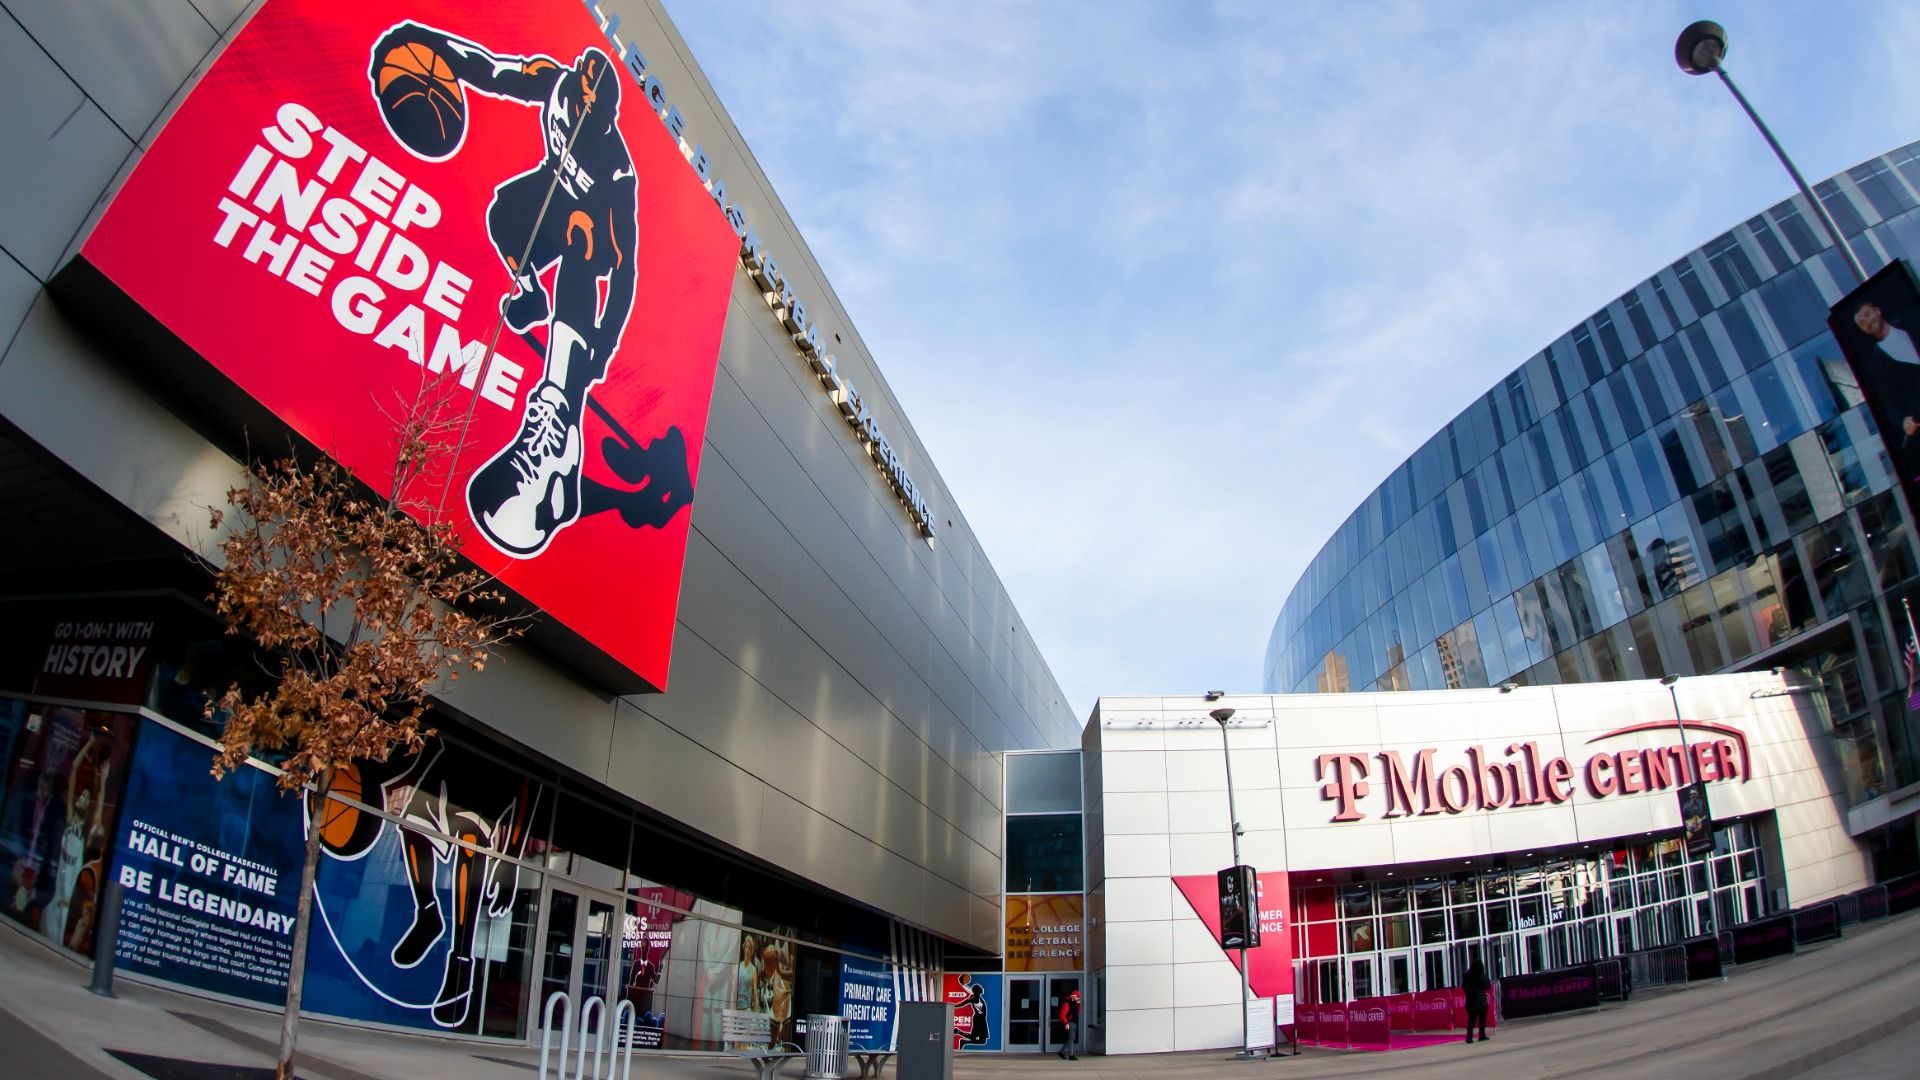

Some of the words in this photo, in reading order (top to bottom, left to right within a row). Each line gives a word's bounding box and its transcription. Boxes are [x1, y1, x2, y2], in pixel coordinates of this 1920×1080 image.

[261, 102, 441, 231] STEP
[229, 144, 473, 322] INSIDE
[211, 197, 335, 298] THE
[330, 276, 525, 411] GAME
[847, 379, 937, 537] EXPERIENCE
[54, 622, 74, 639] GO
[74, 622, 113, 640] 1-ON-1
[115, 621, 155, 640] WITH
[43, 645, 147, 679] HISTORY
[1380, 740, 1576, 819] Mobile
[1586, 737, 1744, 799] CENTER
[128, 830, 184, 867] HALL
[190, 853, 220, 877] OF
[223, 863, 278, 896] FAME
[133, 819, 169, 839] OFFICIAL
[171, 833, 196, 848] MEN'S
[196, 843, 231, 861] COLLEGE
[232, 854, 279, 877] BASKETBALL
[119, 865, 153, 895] BE
[158, 878, 296, 935] LEGENDARY
[1258, 909, 1283, 921] MER
[127, 910, 139, 919] one
[140, 914, 158, 925] place
[158, 919, 165, 927] in
[165, 920, 176, 930] the
[177, 925, 199, 938] country
[200, 931, 218, 942] where
[219, 936, 242, 949] legends
[243, 942, 253, 951] live
[144, 903, 156, 914] The
[156, 907, 181, 921] National
[181, 915, 210, 930] Collegiate
[210, 923, 239, 937] Basketball
[239, 931, 251, 941] Hall
[275, 940, 287, 950] This
[624, 914, 648, 931] KC'S
[624, 931, 644, 940] MOST
[648, 931, 672, 940] UNIQUE
[1033, 924, 1081, 933] COLLEGE
[1259, 921, 1283, 933] NCE
[119, 929, 149, 943] ntributors
[150, 938, 164, 947] who
[165, 942, 180, 952] were
[182, 946, 192, 955] the
[193, 950, 210, 960] kings
[211, 954, 218, 962] of
[219, 956, 229, 964] the
[248, 963, 265, 973] Come
[266, 967, 282, 976] share
[122, 951, 132, 959] off
[132, 953, 143, 963] the
[128, 921, 141, 930] can
[142, 926, 155, 936] pay
[157, 929, 183, 943] homage
[184, 937, 192, 945] to
[193, 939, 204, 948] the
[259, 956, 278, 967] teams
[279, 960, 290, 969] and
[622, 940, 642, 949] EVENT
[650, 940, 669, 949] VENUE
[1008, 936, 1081, 946] BASKETBALL
[1008, 949, 1081, 959] EXPERIENCE
[122, 940, 138, 952] glory
[139, 945, 146, 953] of
[147, 947, 161, 956] their
[162, 951, 189, 964] triumphs
[189, 958, 202, 967] and
[218, 965, 231, 975] how
[231, 968, 251, 980] history
[264, 977, 280, 986] made
[844, 982, 875, 1002] PRIMARY
[876, 986, 892, 1004] CARE
[842, 1003, 871, 1021] URGENT
[871, 1006, 888, 1022] CARE
[1368, 1012, 1385, 1022] CENTER
